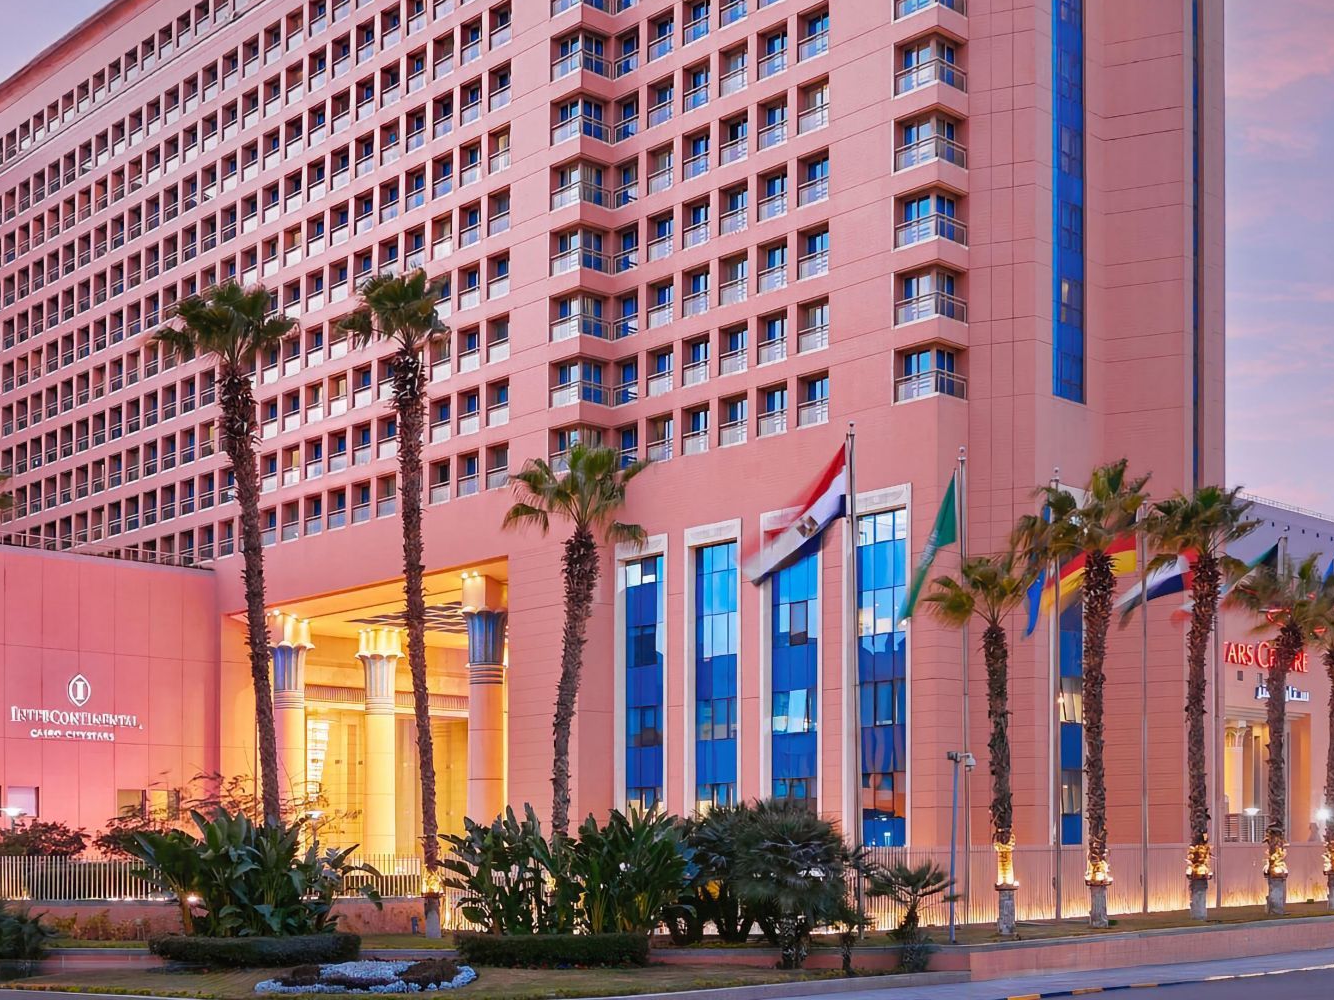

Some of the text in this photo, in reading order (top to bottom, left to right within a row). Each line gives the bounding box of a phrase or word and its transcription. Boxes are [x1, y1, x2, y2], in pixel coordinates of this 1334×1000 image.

[1223, 641, 1309, 672] TARS CERE
[10, 705, 138, 728] INTERCONTINENTAL
[30, 728, 115, 742] CAIRO CITYSTARS
